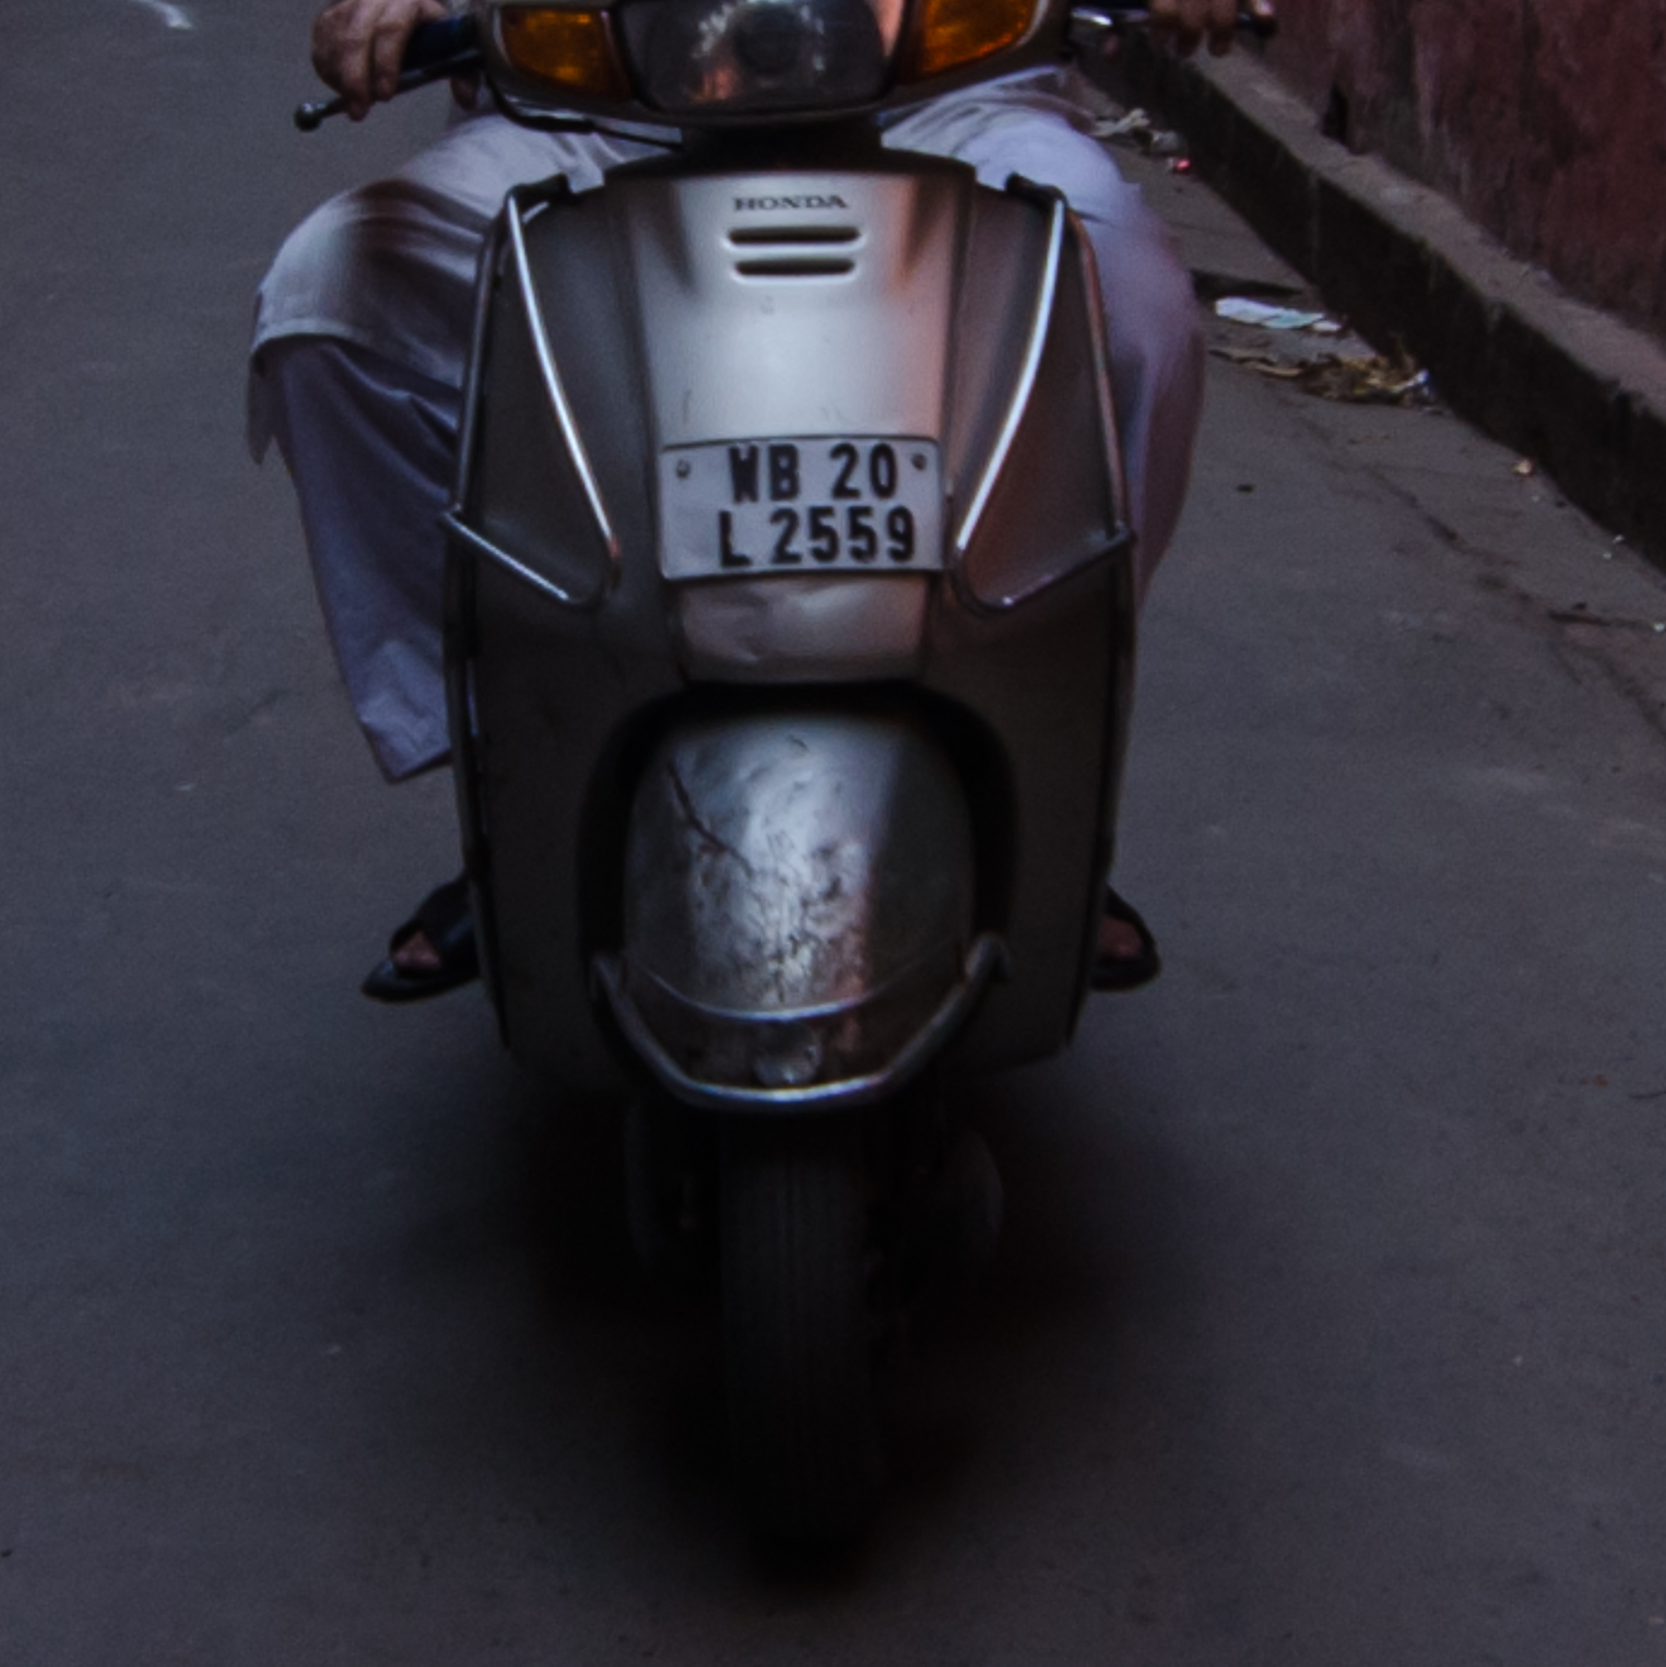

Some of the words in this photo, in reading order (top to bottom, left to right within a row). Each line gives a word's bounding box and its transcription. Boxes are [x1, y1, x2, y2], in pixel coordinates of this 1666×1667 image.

[734, 194, 850, 212] HONDA
[728, 443, 800, 503] WB
[830, 442, 898, 501] 20
[719, 509, 752, 568] L
[770, 505, 915, 565] 2559
